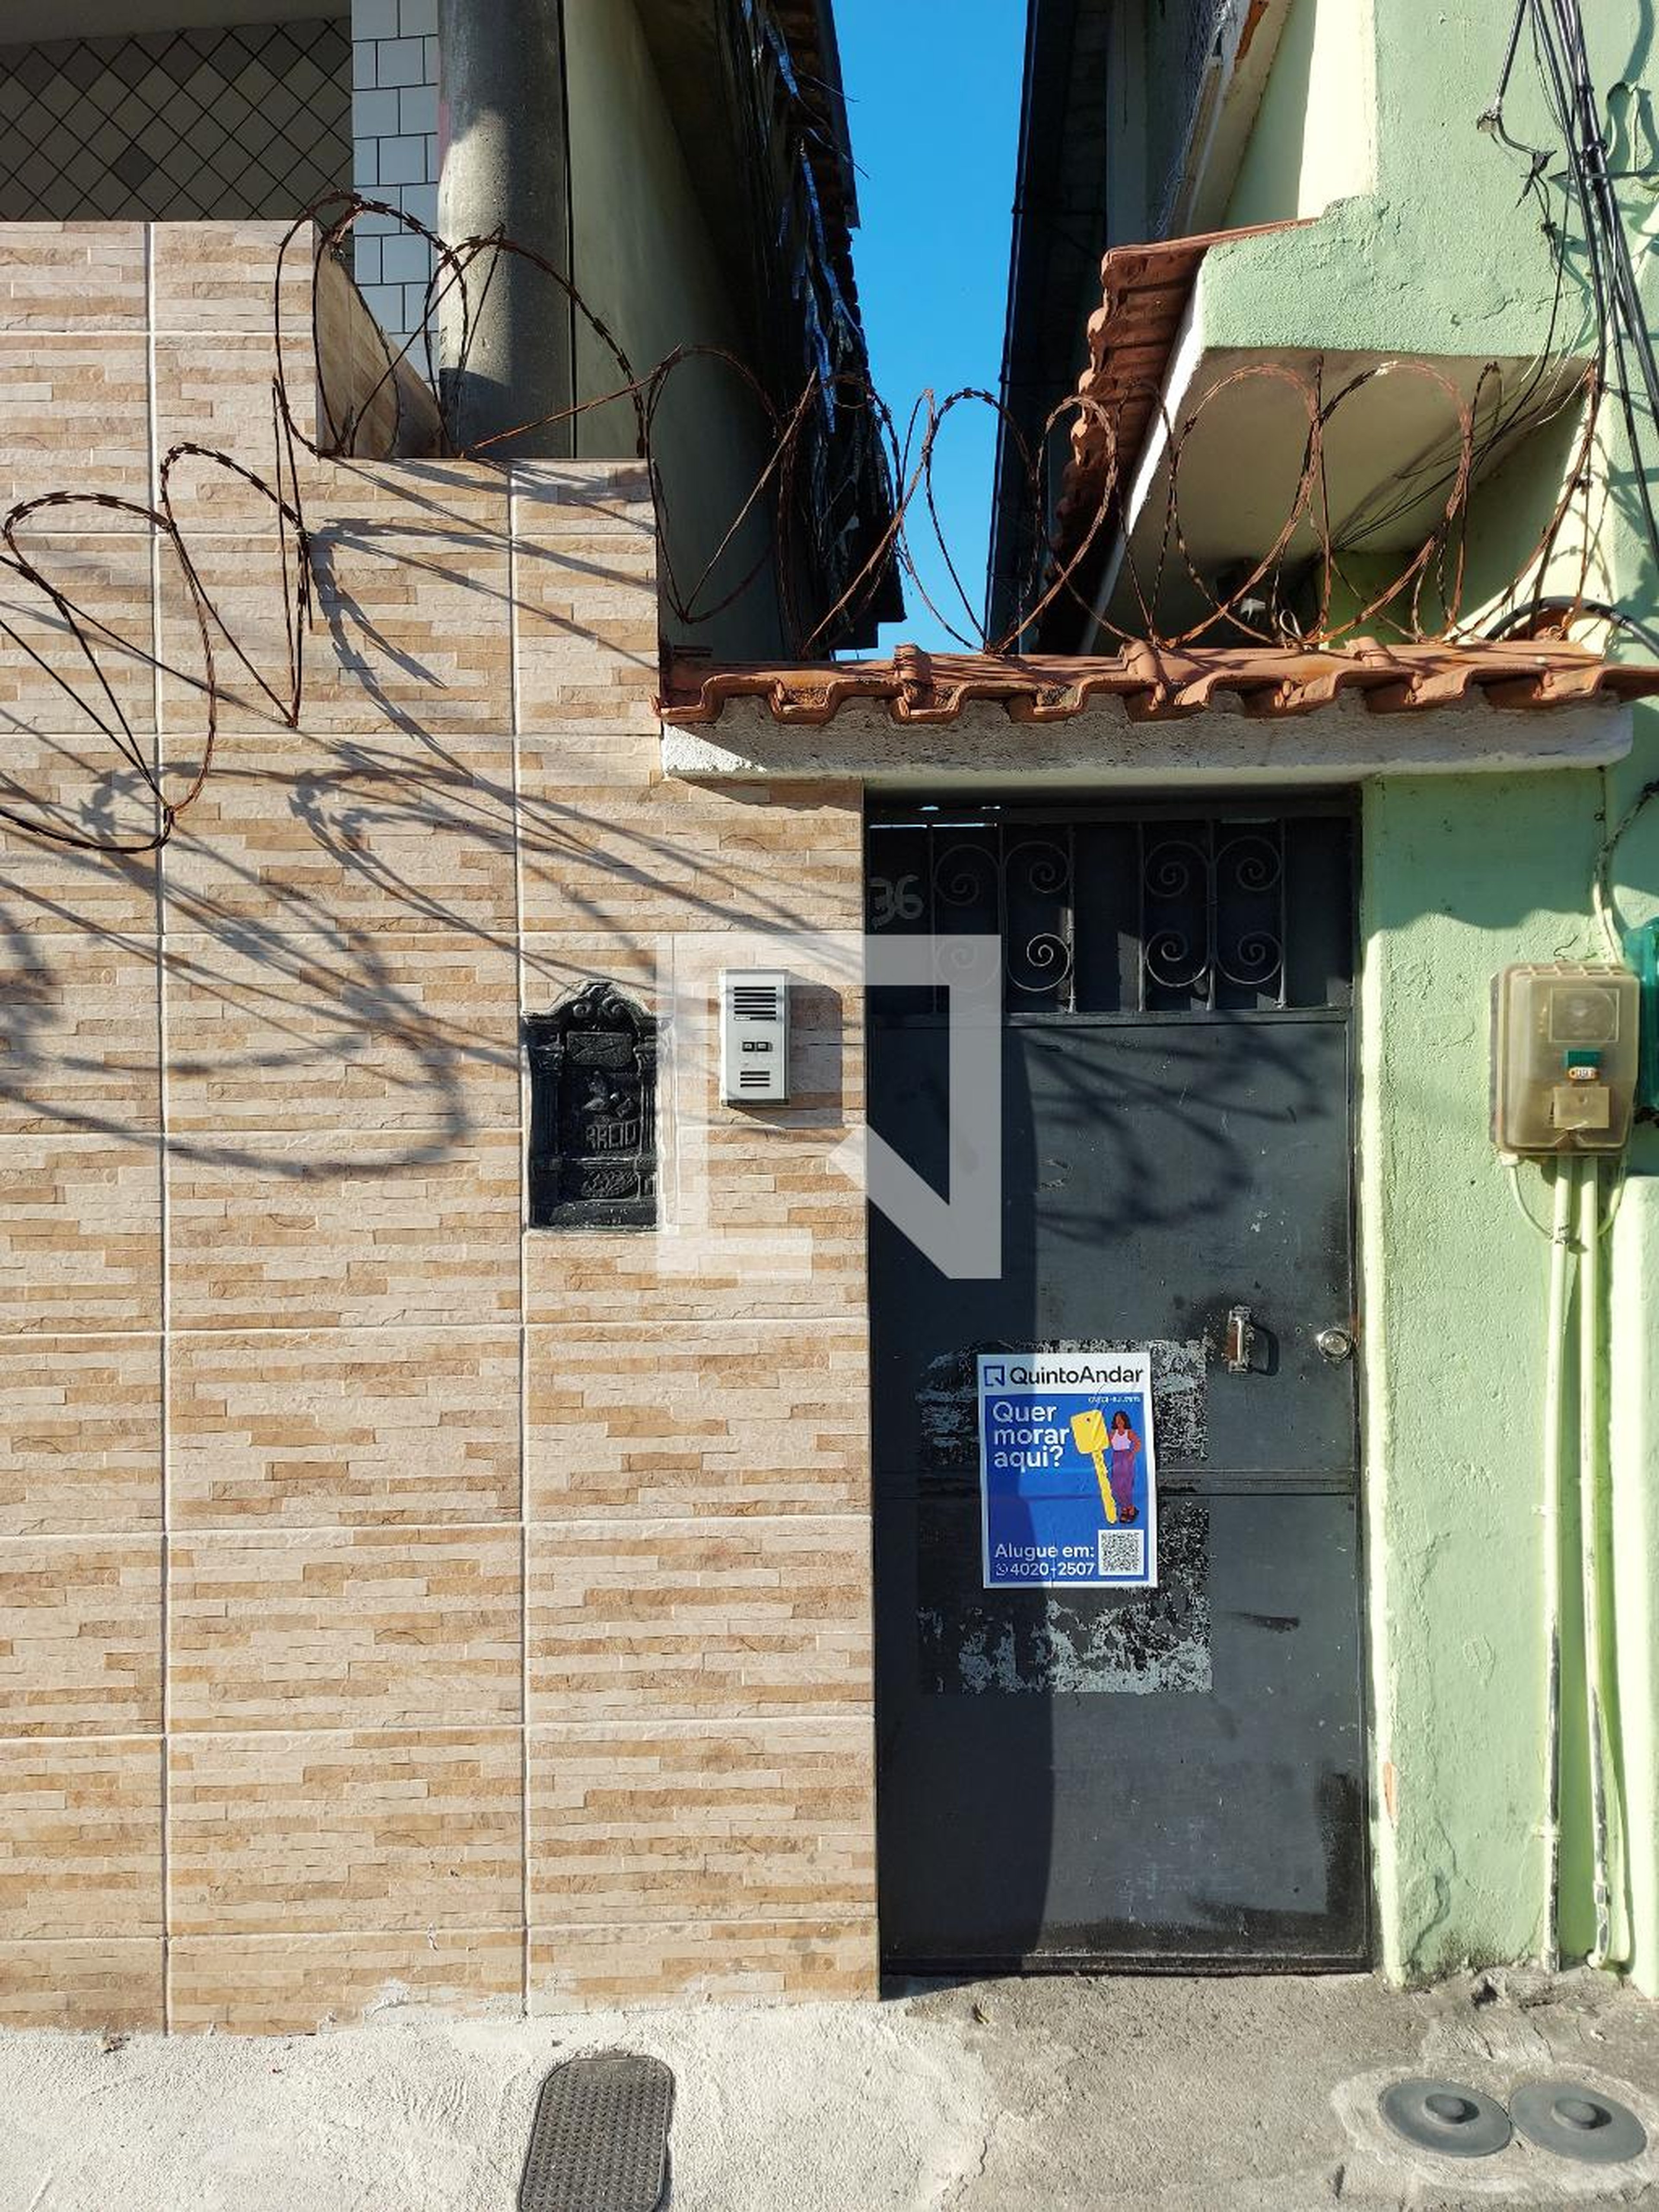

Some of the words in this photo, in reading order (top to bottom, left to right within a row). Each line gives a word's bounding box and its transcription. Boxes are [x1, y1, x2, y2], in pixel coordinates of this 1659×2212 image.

[868, 874, 924, 926] 36
[1010, 1365, 1143, 1384] QuintoAndar
[993, 1401, 1057, 1423] Quer
[994, 1428, 1070, 1445] morar
[994, 1445, 1064, 1473] aqui?
[995, 1543, 1058, 1561] Alugue
[1062, 1546, 1094, 1558] em:
[1010, 1562, 1095, 1576] 4020-2507
